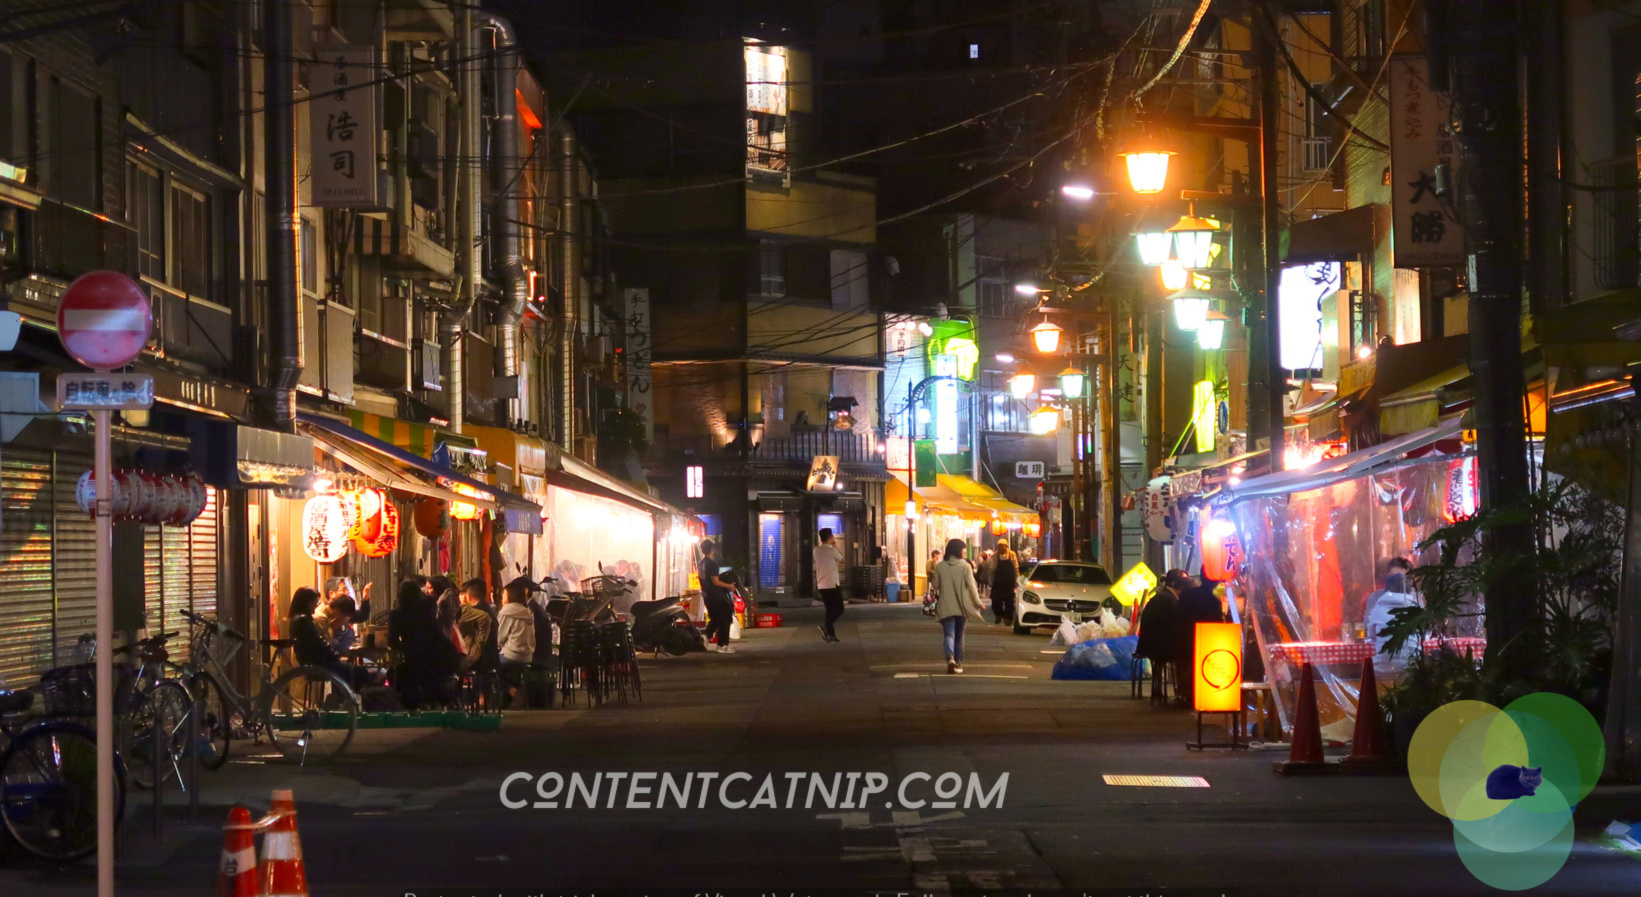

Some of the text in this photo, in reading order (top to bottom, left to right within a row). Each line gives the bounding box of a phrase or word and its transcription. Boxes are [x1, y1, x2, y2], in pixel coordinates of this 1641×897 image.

[325, 111, 358, 180] 浩司
[1409, 171, 1446, 245] 大勝
[1017, 463, 1043, 476] 珈琲
